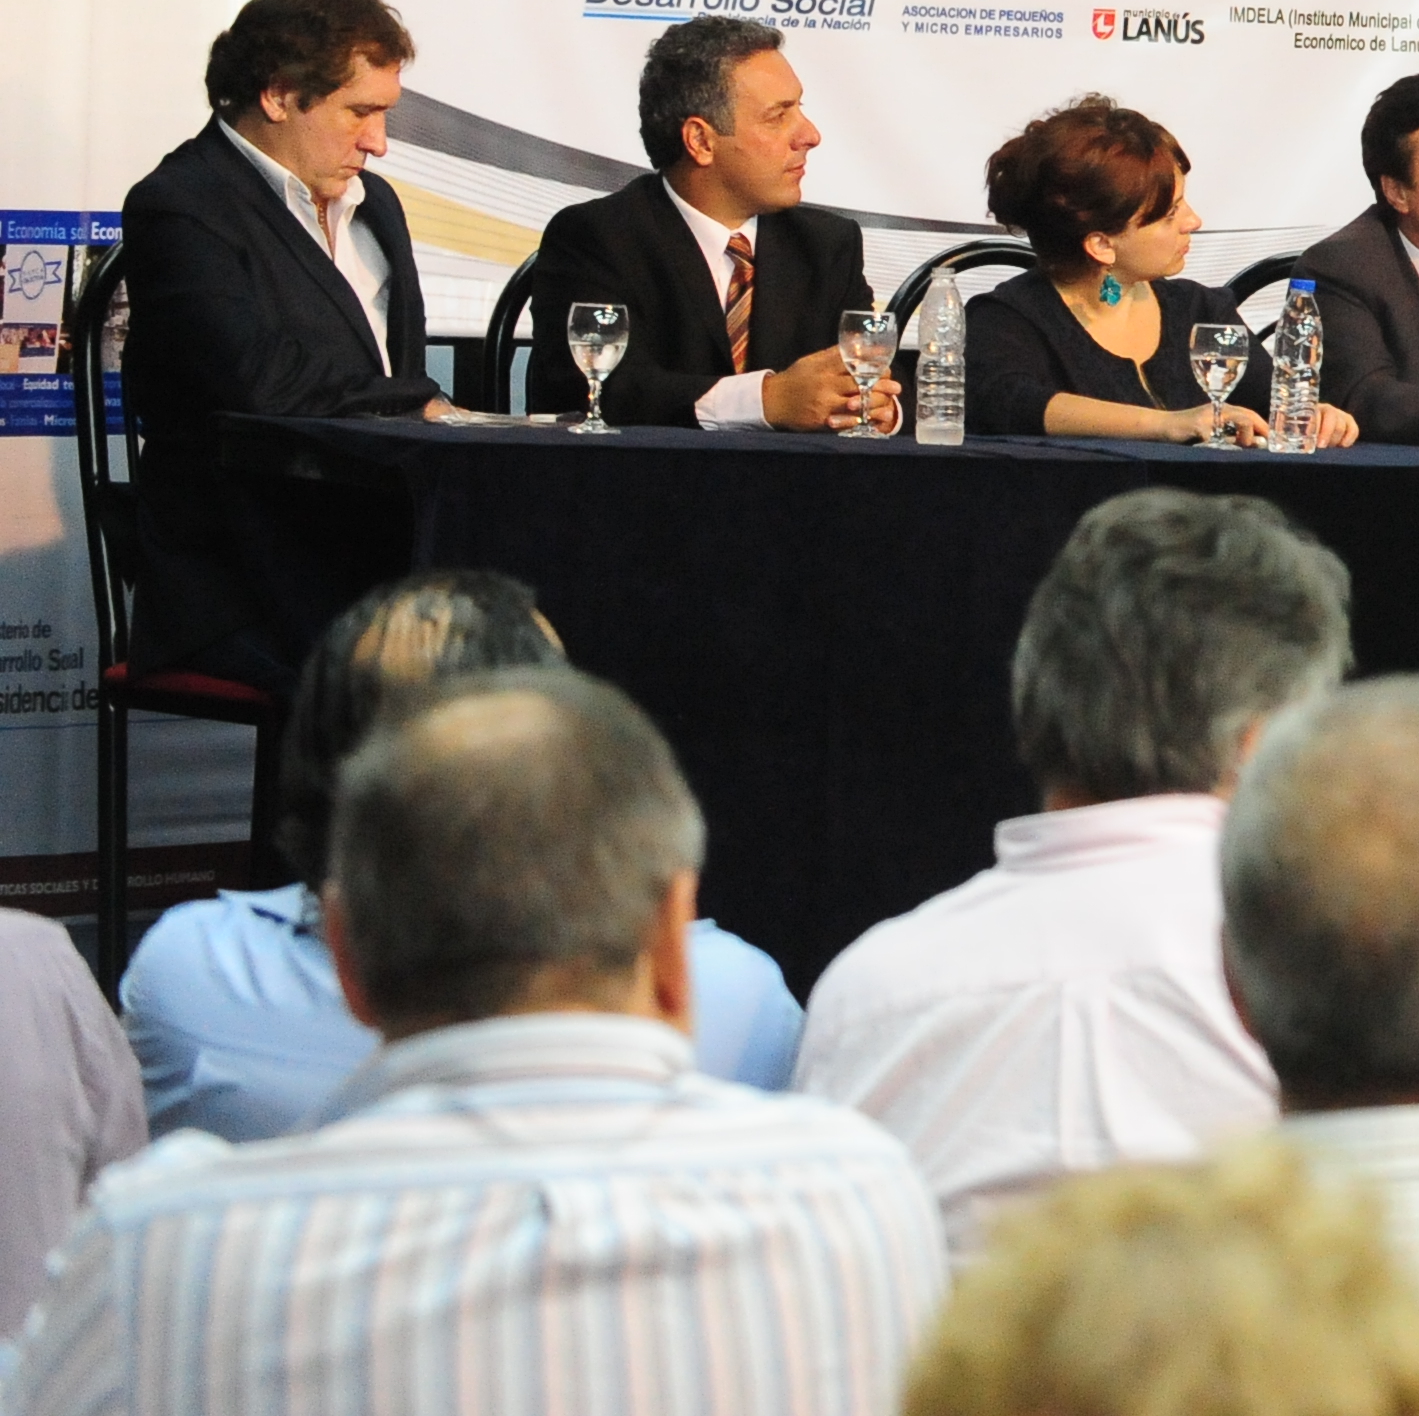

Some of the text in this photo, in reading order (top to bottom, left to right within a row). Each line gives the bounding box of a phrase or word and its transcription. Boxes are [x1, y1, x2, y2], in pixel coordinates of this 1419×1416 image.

[781, 14, 800, 29] de
[803, 15, 816, 29] la
[821, 17, 872, 32] Nación
[902, 5, 1064, 24] ASOCIACION DE PEQUEÑOS
[1229, 6, 1285, 25] IMDELA
[1288, 9, 1345, 29] (Instituto
[1348, 11, 1412, 32] Municipal
[901, 21, 1064, 40] Y MICRO EMPRESARIOS
[1122, 12, 1206, 45] LANÚS
[1294, 32, 1366, 52] Económico
[1369, 35, 1387, 52] de
[32, 618, 52, 639] de
[71, 679, 100, 712] de
